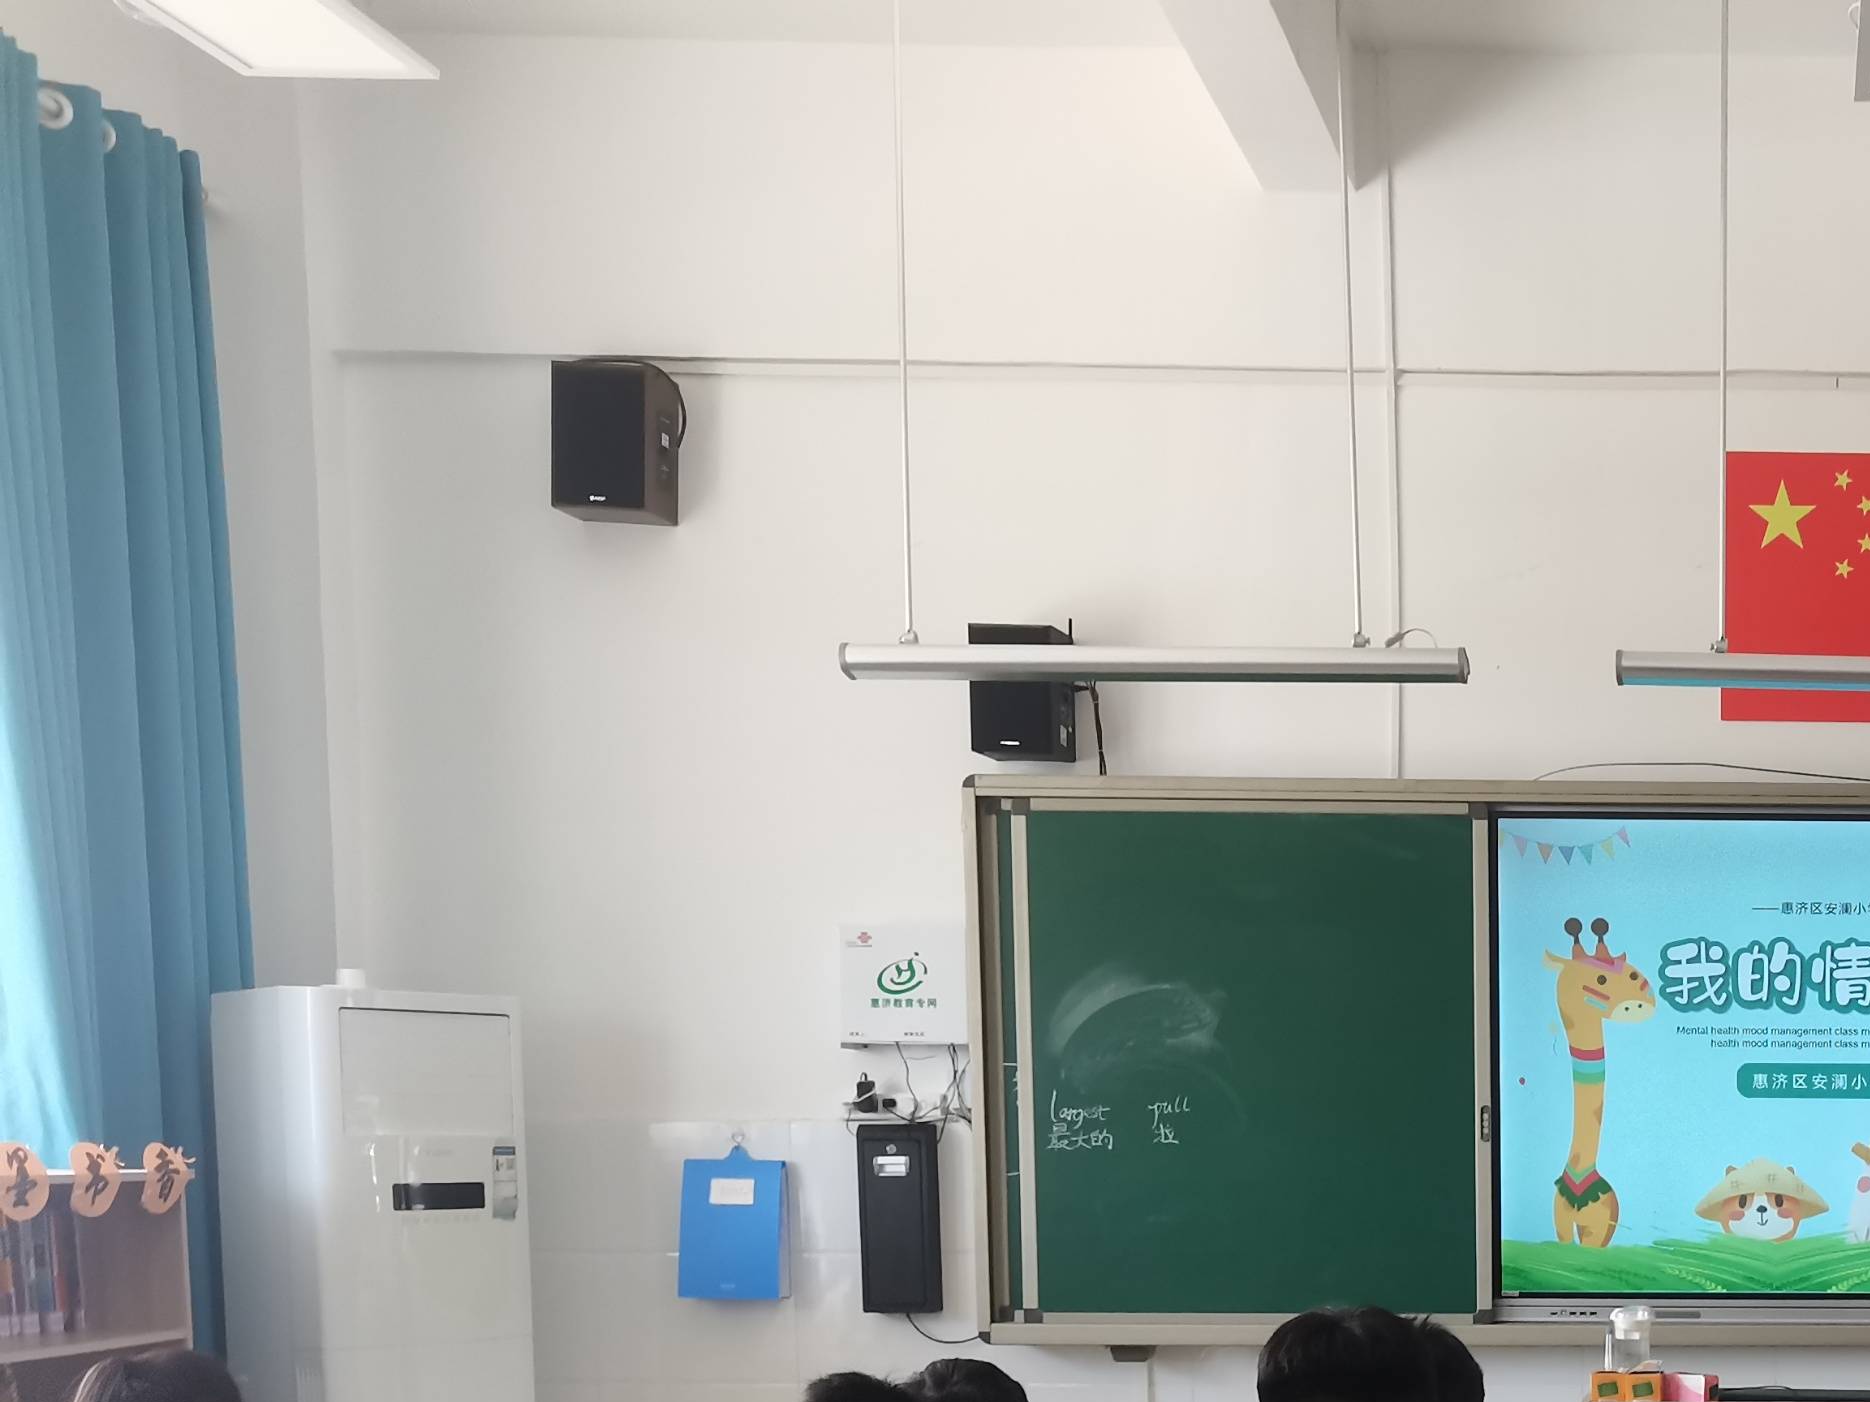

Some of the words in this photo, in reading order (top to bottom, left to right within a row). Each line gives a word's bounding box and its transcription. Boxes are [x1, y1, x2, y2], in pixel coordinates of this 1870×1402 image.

[1676, 1026, 1709, 1036] Mental
[1710, 1026, 1740, 1036] health
[1742, 1027, 1769, 1036] mood
[1771, 1027, 1833, 1038] management
[1834, 1027, 1859, 1036] class
[1710, 1039, 1740, 1048] health
[1742, 1039, 1769, 1048] mood
[1771, 1039, 1833, 1049] management
[1834, 1039, 1859, 1049] class
[1050, 1089, 1111, 1129] largest
[1147, 1096, 1191, 1129] pull
[1047, 1123, 1113, 1150] 最大的
[1153, 1123, 1180, 1144] 拉
